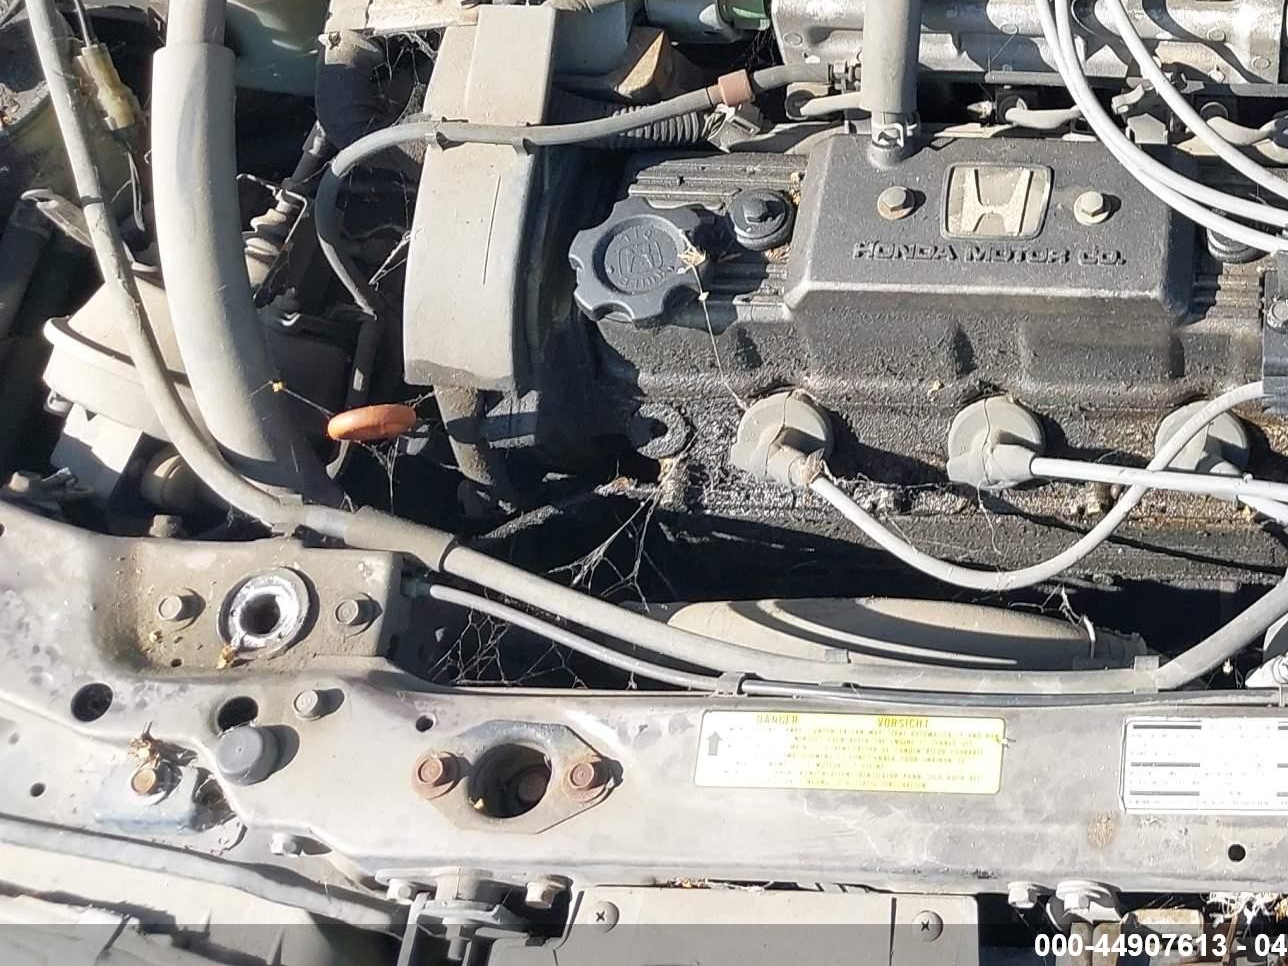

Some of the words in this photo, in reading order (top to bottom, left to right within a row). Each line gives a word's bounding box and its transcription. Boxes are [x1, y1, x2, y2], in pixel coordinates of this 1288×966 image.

[853, 240, 957, 262] HONDA
[963, 244, 1071, 264] MOTOR
[1078, 247, 1127, 266] CO.
[756, 714, 799, 725] DANGER
[877, 717, 929, 729] VORSICHT
